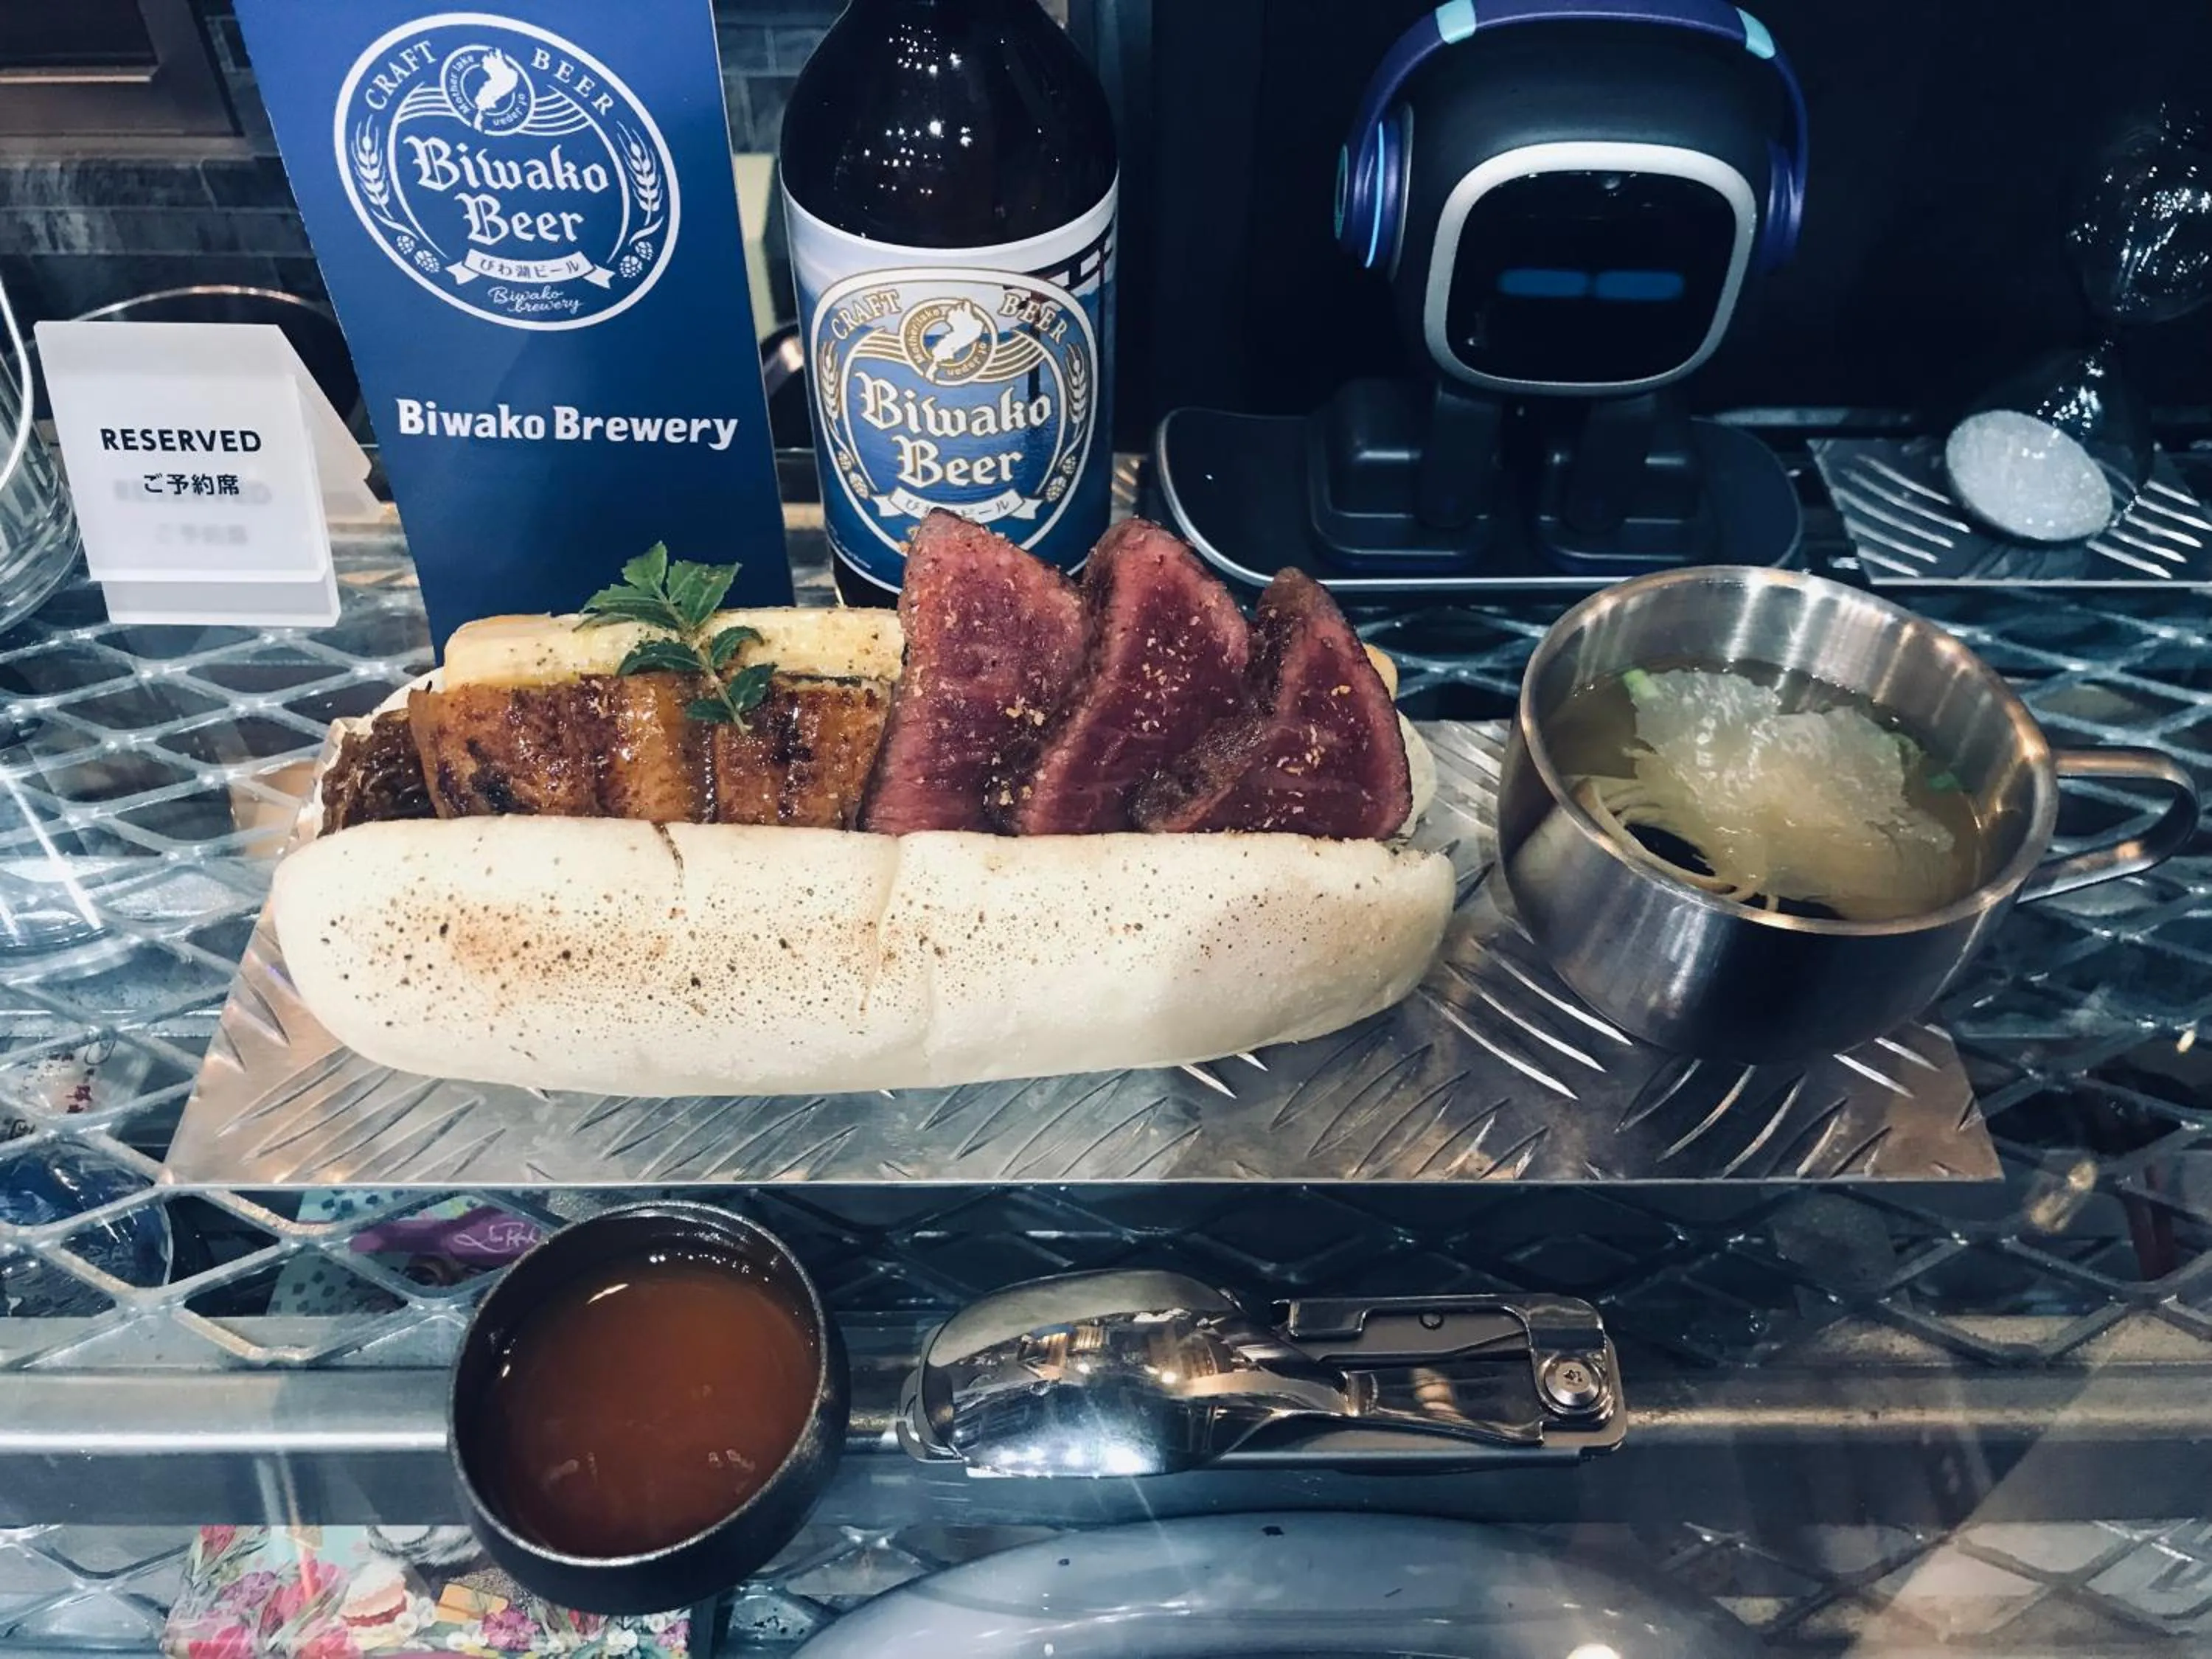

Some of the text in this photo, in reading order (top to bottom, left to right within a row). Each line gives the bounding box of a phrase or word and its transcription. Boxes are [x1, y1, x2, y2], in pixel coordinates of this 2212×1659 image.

[365, 41, 613, 116] CRAFT BEER
[403, 136, 609, 193] Biwako
[454, 192, 584, 246] Beer
[481, 258, 580, 278] びわ湖ビール
[487, 285, 564, 305] Biwako
[831, 289, 1068, 346] CRAFT BEER
[395, 398, 738, 451] Biwako Brewery
[855, 371, 1051, 437] Biwako
[100, 428, 262, 452] RESERVED
[891, 435, 1023, 488] Beer
[144, 473, 240, 495] ご予約席
